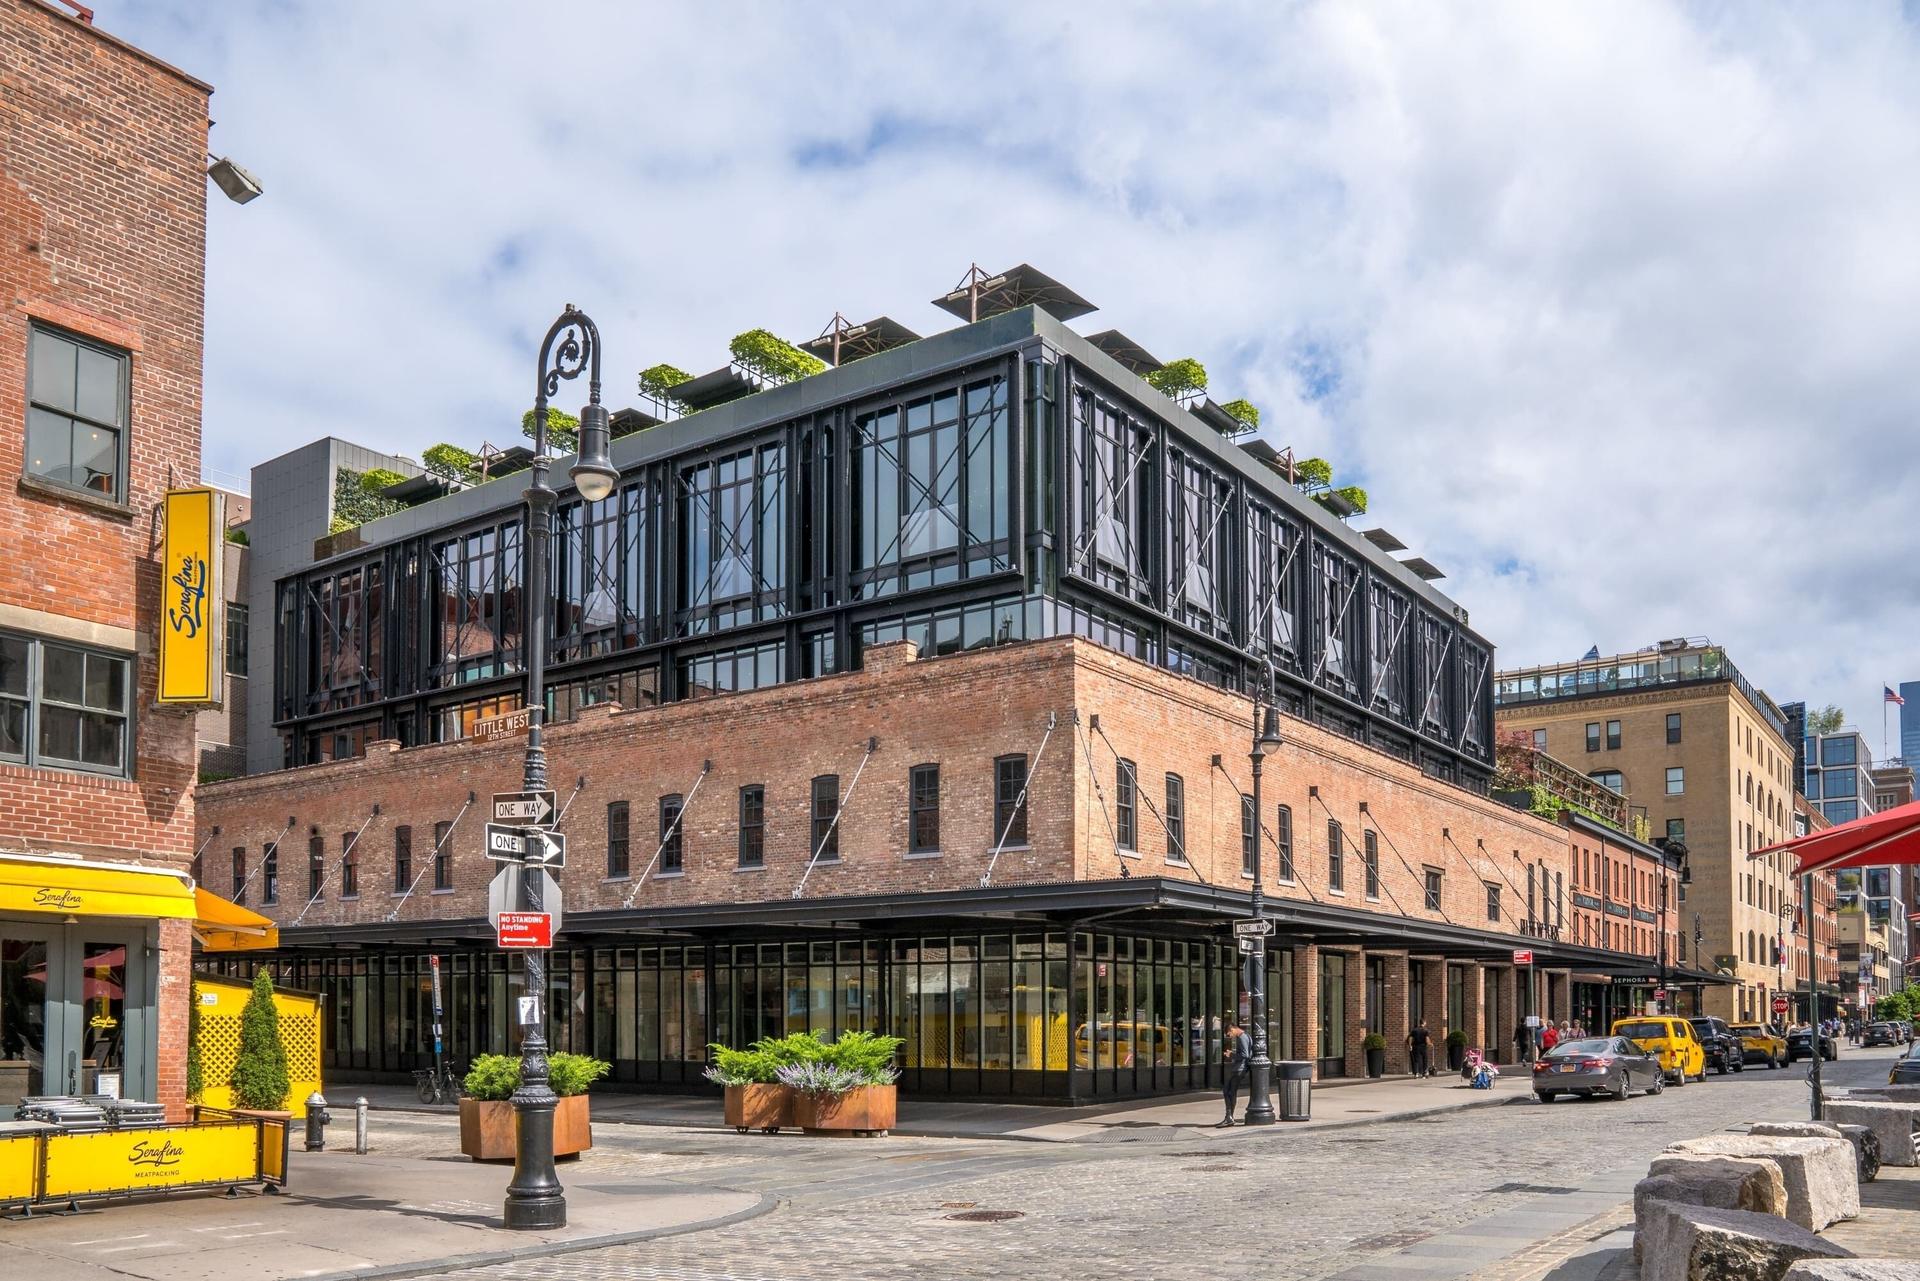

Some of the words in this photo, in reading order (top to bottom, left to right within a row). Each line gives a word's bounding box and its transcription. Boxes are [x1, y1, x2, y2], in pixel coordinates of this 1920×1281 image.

[169, 555, 206, 639] Serafina
[474, 719, 504, 737] LITTLE
[506, 713, 530, 730] WEST
[487, 732, 500, 741] 12TH
[500, 729, 516, 739] STREET
[498, 803, 516, 817] ONE
[523, 802, 543, 816] WAY
[495, 835, 517, 851] ONE
[33, 888, 82, 909] Serafina
[500, 915, 511, 923] NO
[511, 915, 544, 924] STANDING
[501, 923, 529, 932] Anytime
[1240, 924, 1252, 932] ONE
[1256, 923, 1269, 931] WAY
[128, 1140, 184, 1167] Serafina
[135, 1169, 180, 1178] MEATPACKING
